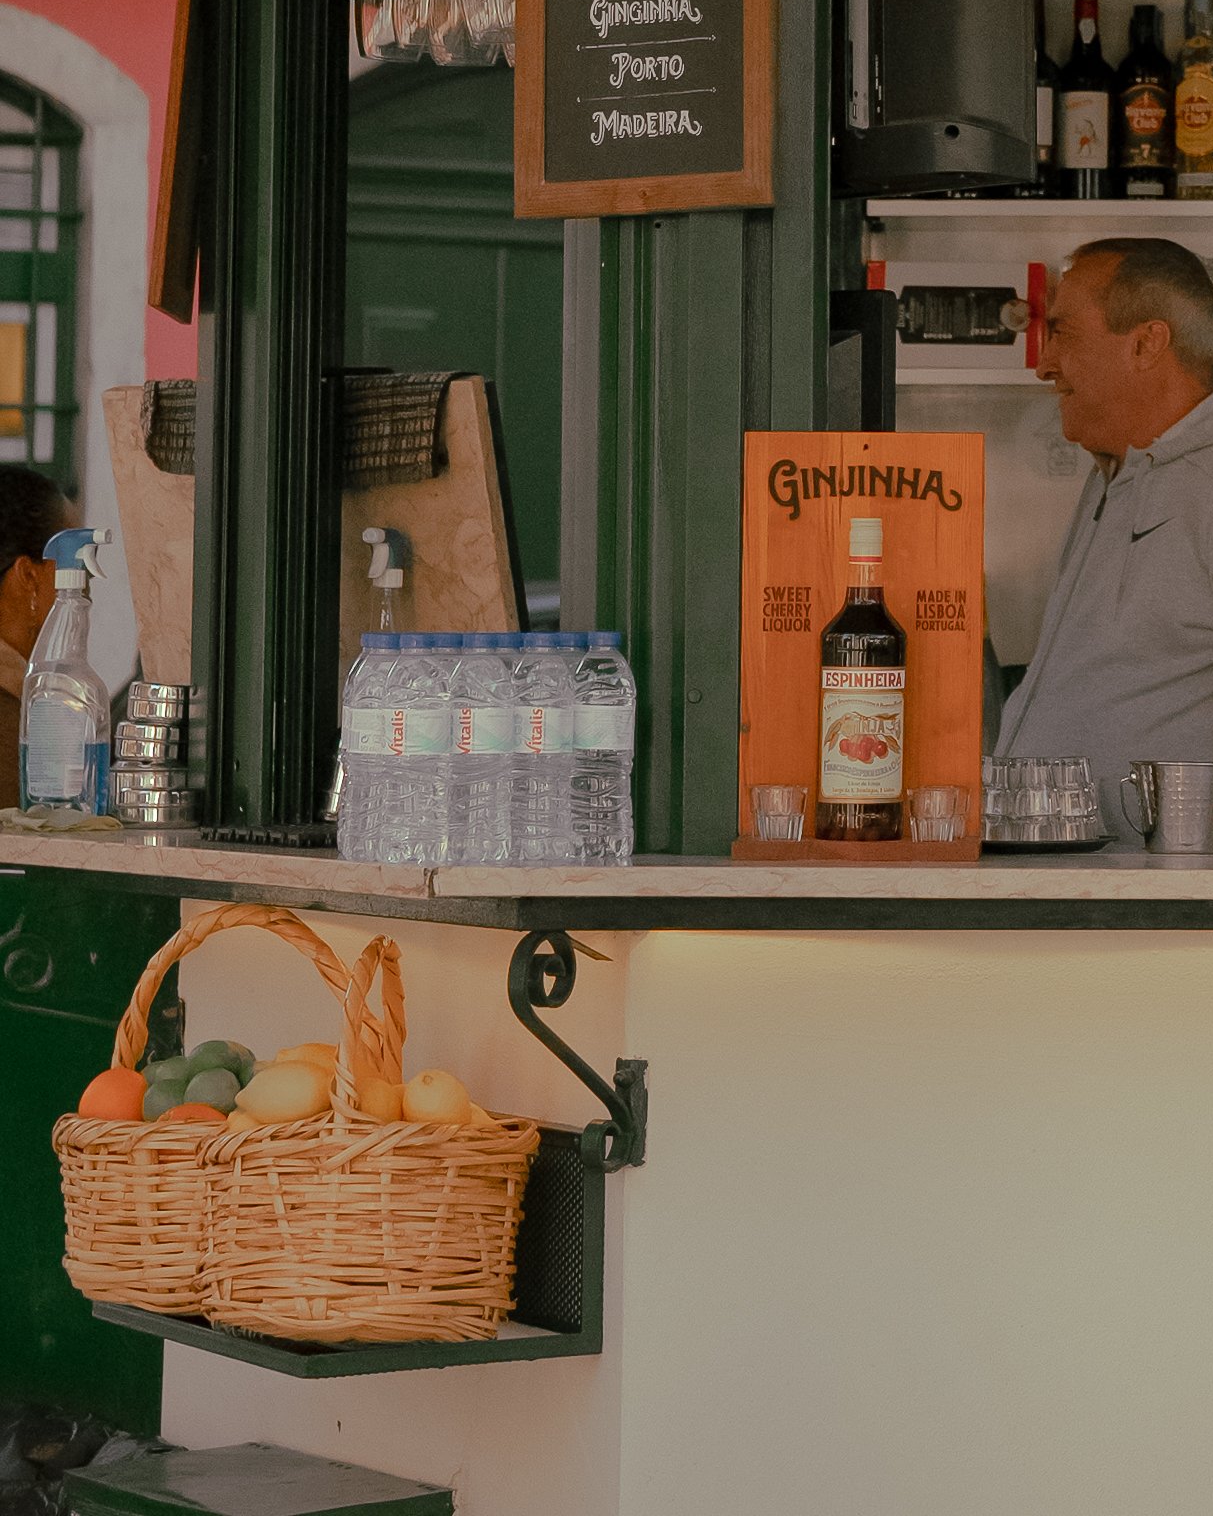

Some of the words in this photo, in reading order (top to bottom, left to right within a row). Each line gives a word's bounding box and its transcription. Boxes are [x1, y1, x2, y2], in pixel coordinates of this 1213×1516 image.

[609, 51, 685, 87] PORTO
[590, 109, 703, 145] MADEIRA
[768, 459, 963, 521] GINJINHA
[763, 587, 811, 603] SWEET
[916, 590, 951, 604] MADE
[954, 590, 967, 604] IN
[763, 603, 811, 618] CHERRY
[916, 604, 966, 619] LISBOA
[762, 618, 811, 633] LIQUOR
[915, 620, 966, 632] PORTUGAL
[825, 672, 902, 688] ESPINHEIRA
[384, 709, 404, 756] Vitalis
[452, 707, 472, 755] Vitalis
[525, 707, 543, 754] Vitalis
